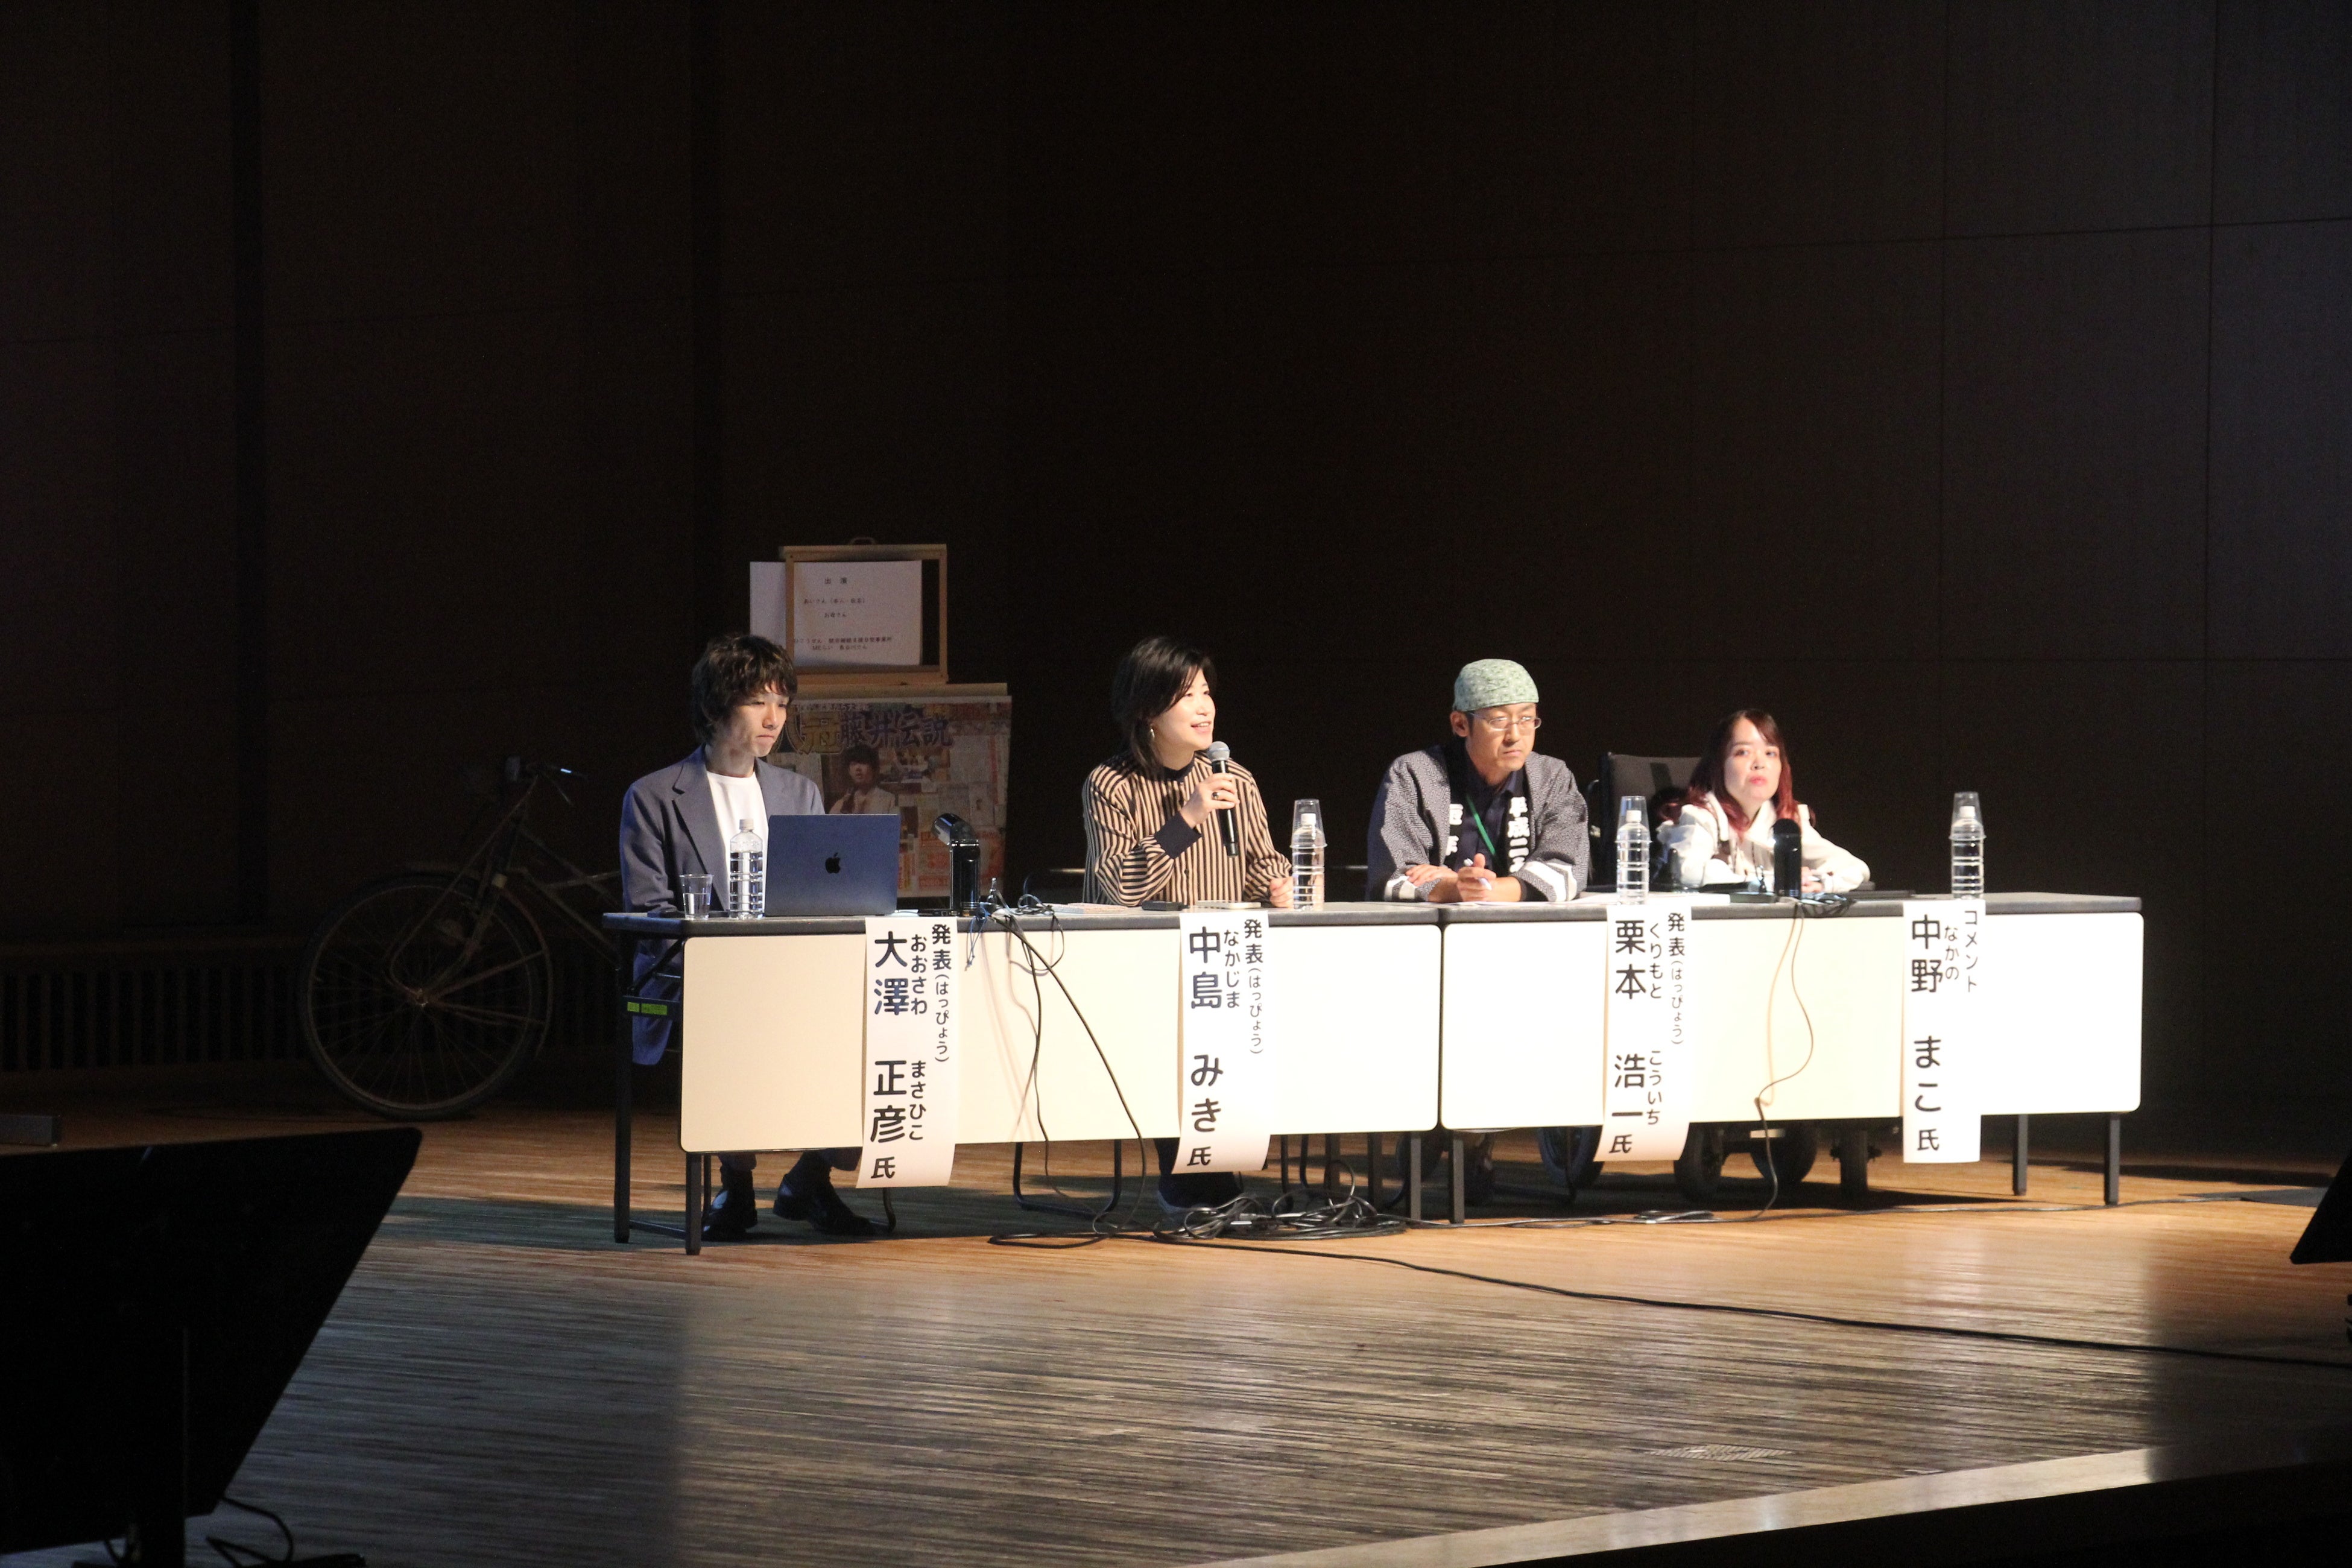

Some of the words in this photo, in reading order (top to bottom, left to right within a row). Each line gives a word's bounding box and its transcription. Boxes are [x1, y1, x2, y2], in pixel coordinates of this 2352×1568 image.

[874, 931, 909, 1016] 大澤
[911, 934, 928, 1015] おおさわ
[1189, 926, 1222, 1009] 中島
[1224, 929, 1241, 1008] なかじま
[1615, 920, 1646, 1000] 栗本
[1649, 923, 1663, 999] くりもと
[1911, 914, 1943, 993] 中野
[1944, 926, 1959, 981] なかの
[1965, 910, 1978, 993] コメント
[909, 1060, 926, 1140] まさひこ
[1646, 1051, 1662, 1125] こういち
